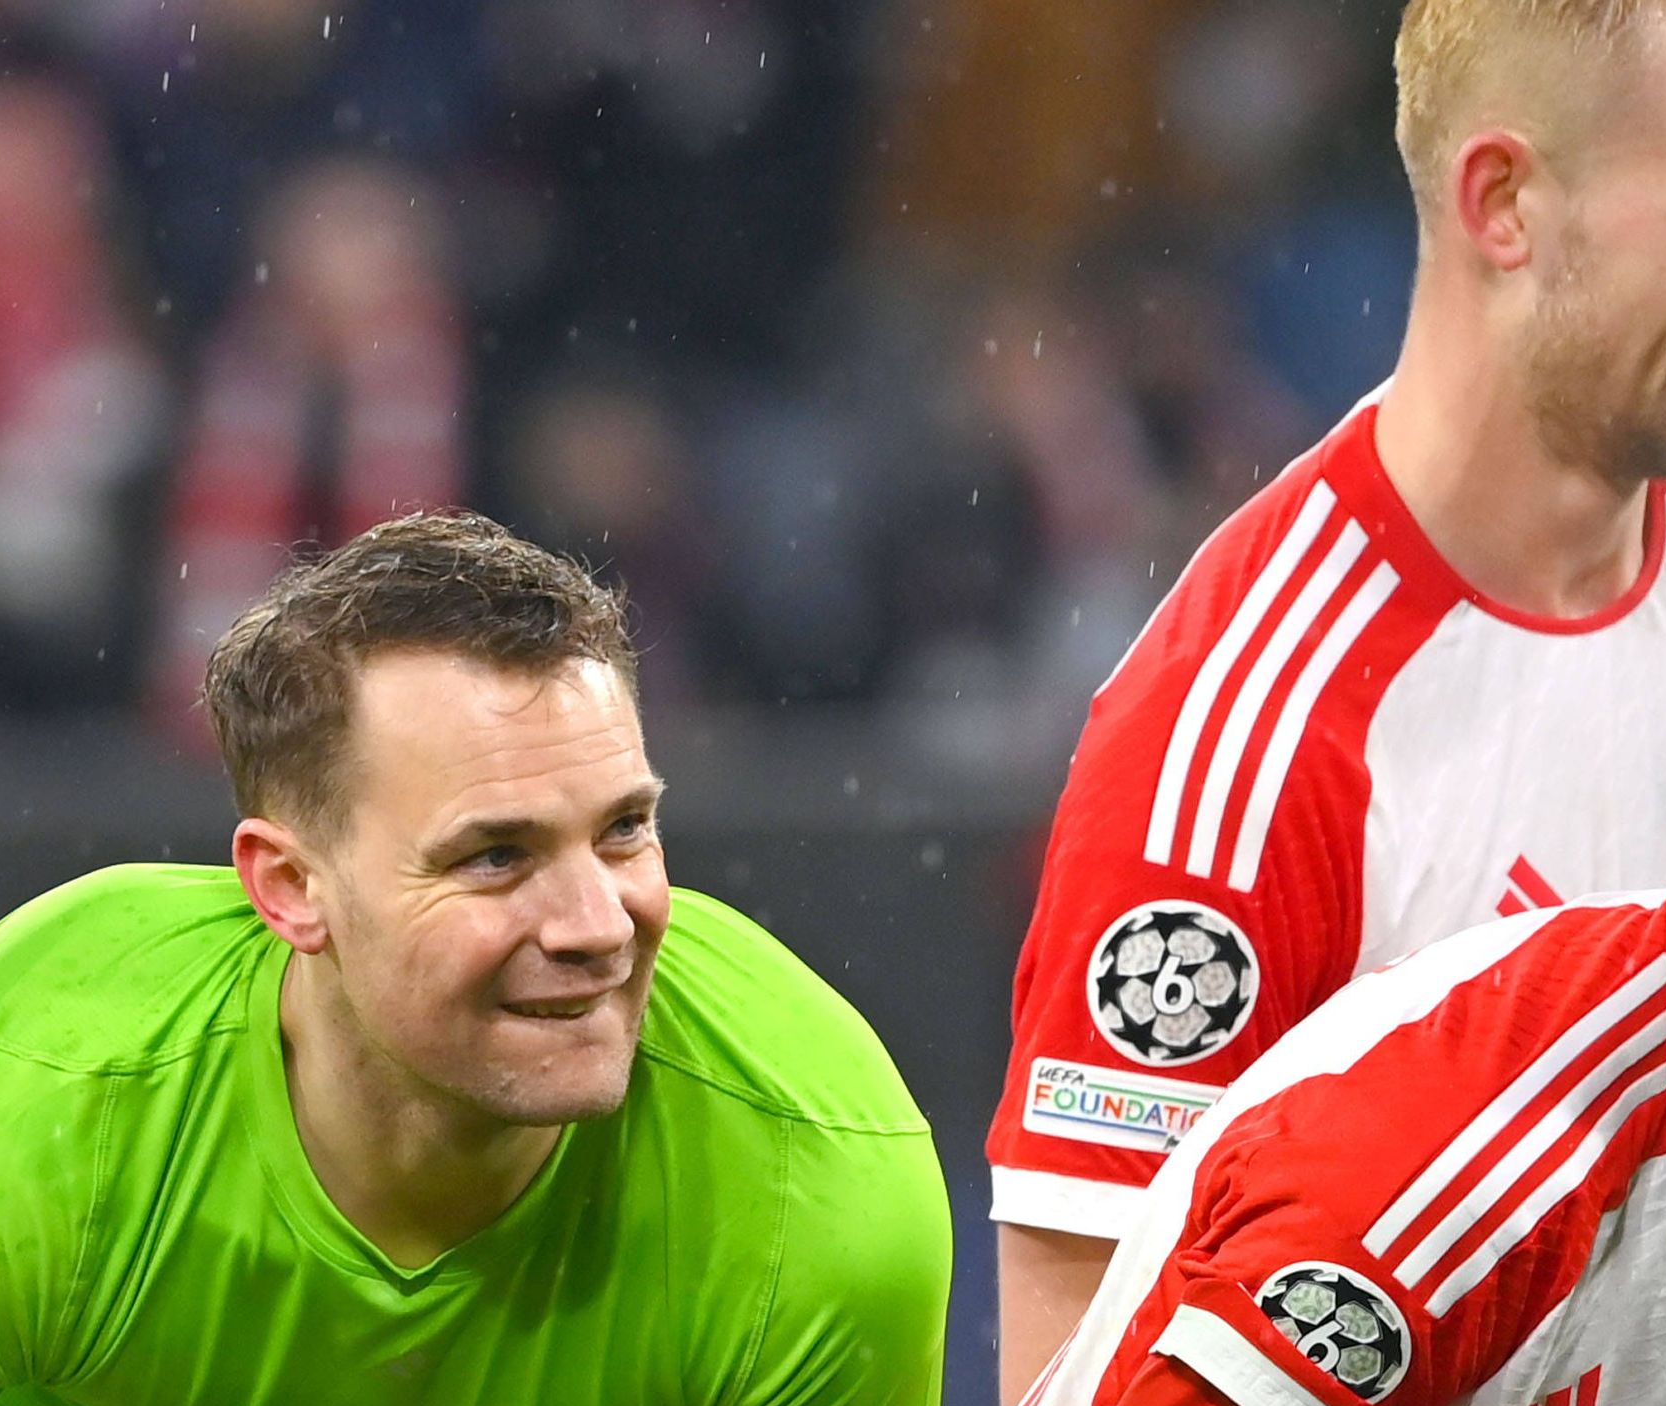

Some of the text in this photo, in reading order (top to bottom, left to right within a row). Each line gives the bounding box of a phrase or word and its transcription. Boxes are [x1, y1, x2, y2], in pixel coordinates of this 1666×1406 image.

[1152, 954, 1195, 1015] 6
[1036, 1065, 1087, 1086] UEFA
[1295, 1319, 1343, 1373] 6
